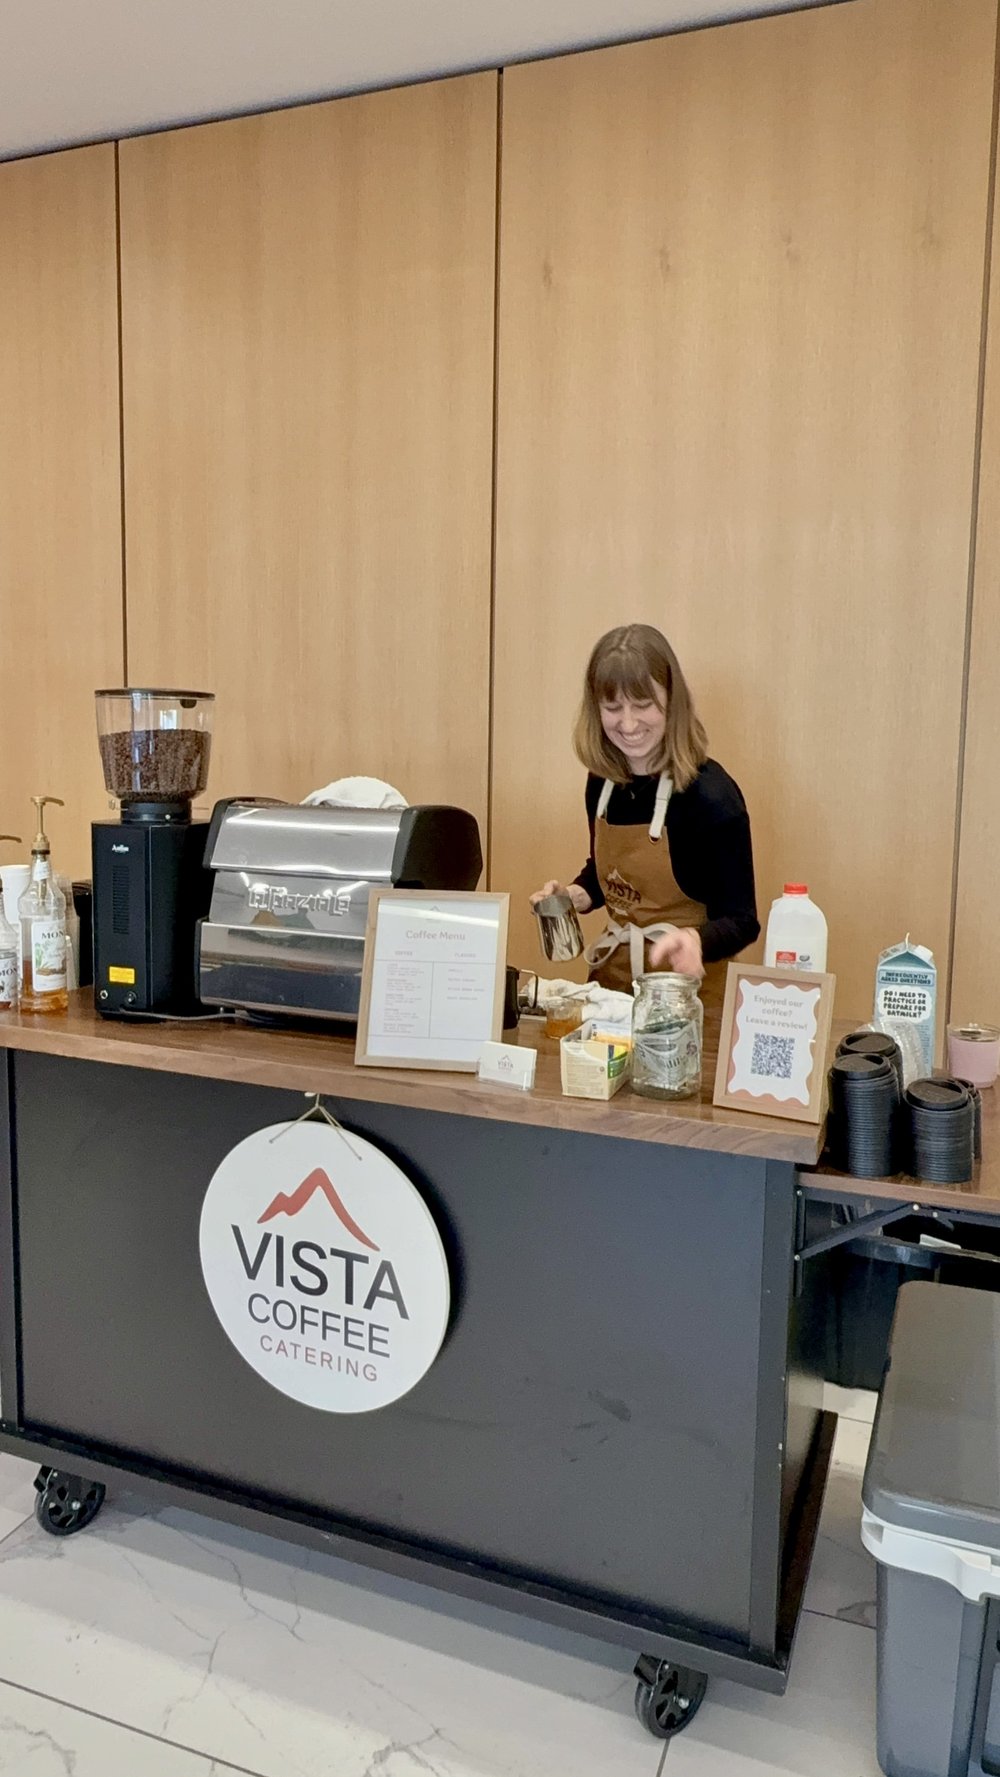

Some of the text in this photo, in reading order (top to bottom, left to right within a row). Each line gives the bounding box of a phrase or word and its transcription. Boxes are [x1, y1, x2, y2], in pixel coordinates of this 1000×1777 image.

[604, 879, 642, 904] VISTA
[405, 930, 466, 941] Coffee Menu
[885, 972, 928, 980] INFREQUENTLY
[899, 977, 931, 985] QUESTIONS
[753, 994, 804, 1008] Enjoyed our
[883, 996, 917, 1005] PRACTICE
[761, 1007, 793, 1017] coffee?
[883, 1002, 913, 1011] PREPARE
[886, 1010, 922, 1018] OATMILK?
[745, 1015, 769, 1026] Leave
[777, 1020, 808, 1031] review!
[230, 1223, 410, 1321] VISTA
[247, 1292, 390, 1358] COFFEE
[259, 1334, 378, 1382] CATERING
